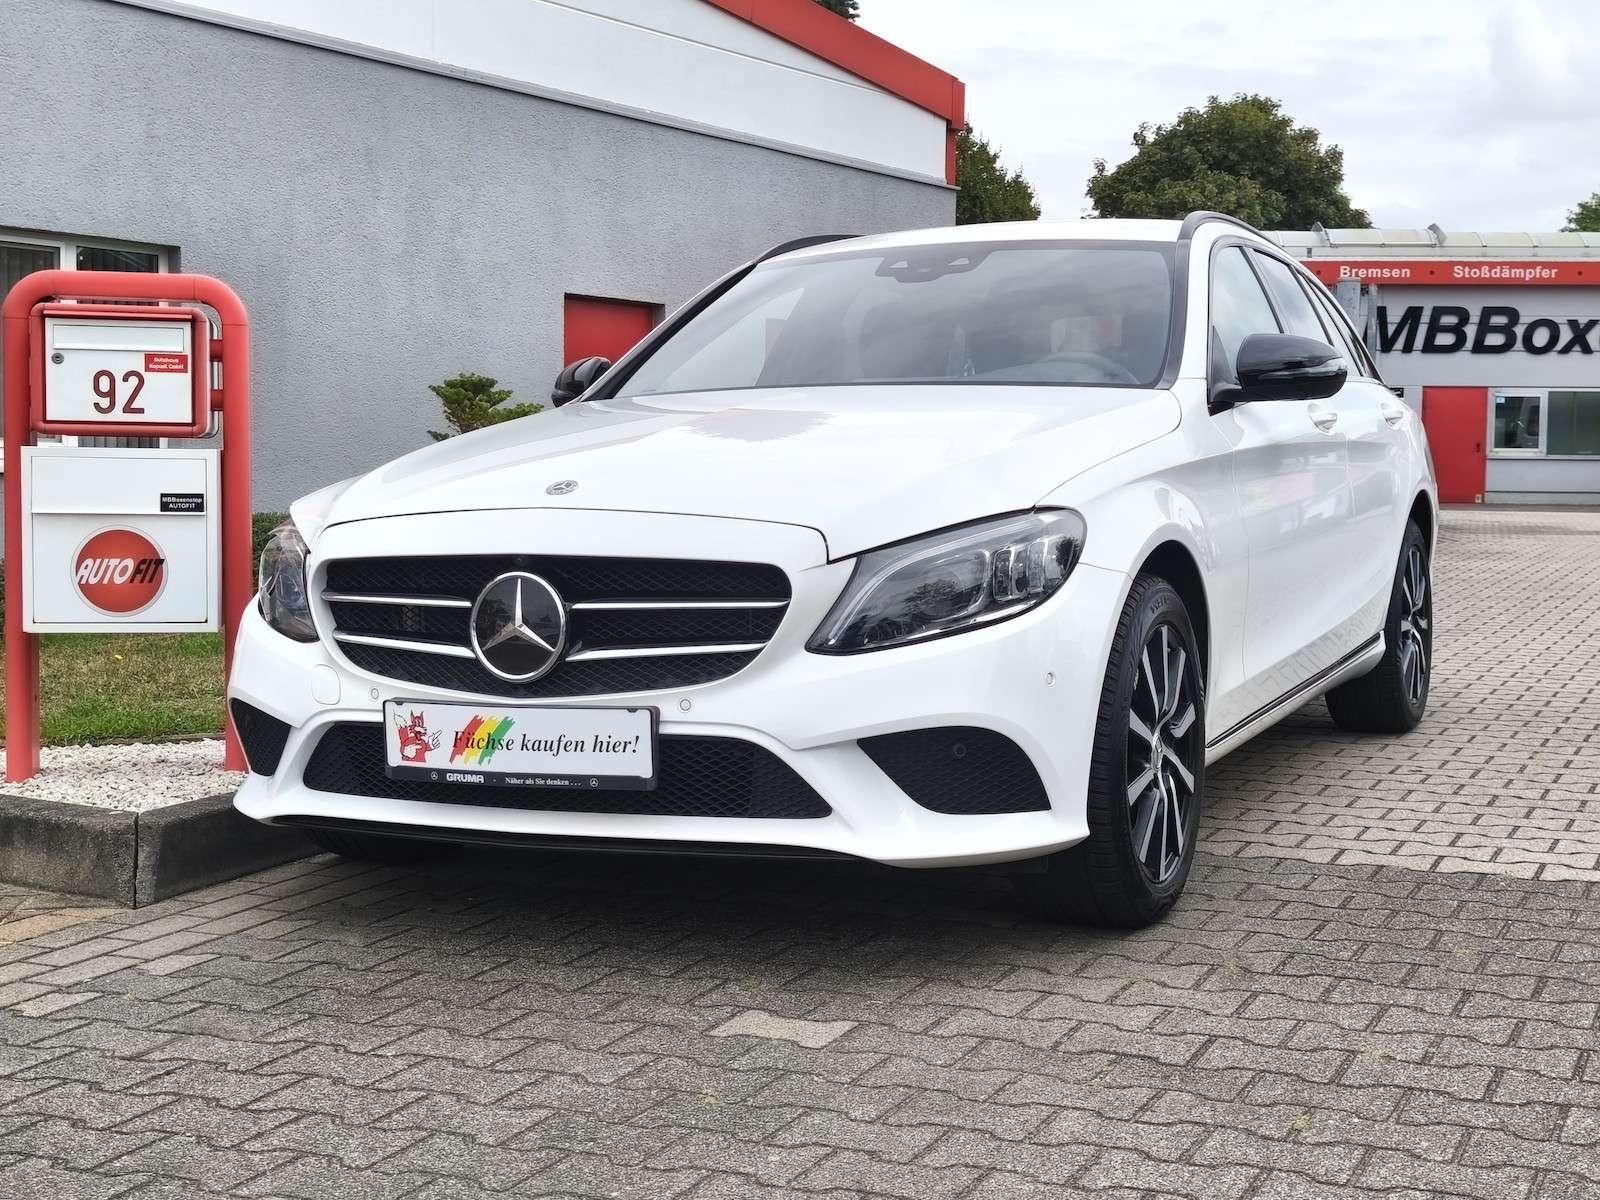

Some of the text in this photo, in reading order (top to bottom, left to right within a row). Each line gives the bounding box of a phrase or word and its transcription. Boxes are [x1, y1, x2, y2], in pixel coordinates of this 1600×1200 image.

[1339, 264, 1559, 281] Bremsen Stoßdämpfer
[93, 369, 145, 415] 92
[75, 557, 166, 585] AUTOFIT
[452, 730, 640, 757] Füchse kaufen hier!
[446, 772, 485, 784] GRUMA
[504, 776, 524, 785] Näher
[524, 777, 535, 785] als
[535, 777, 546, 786] Sie
